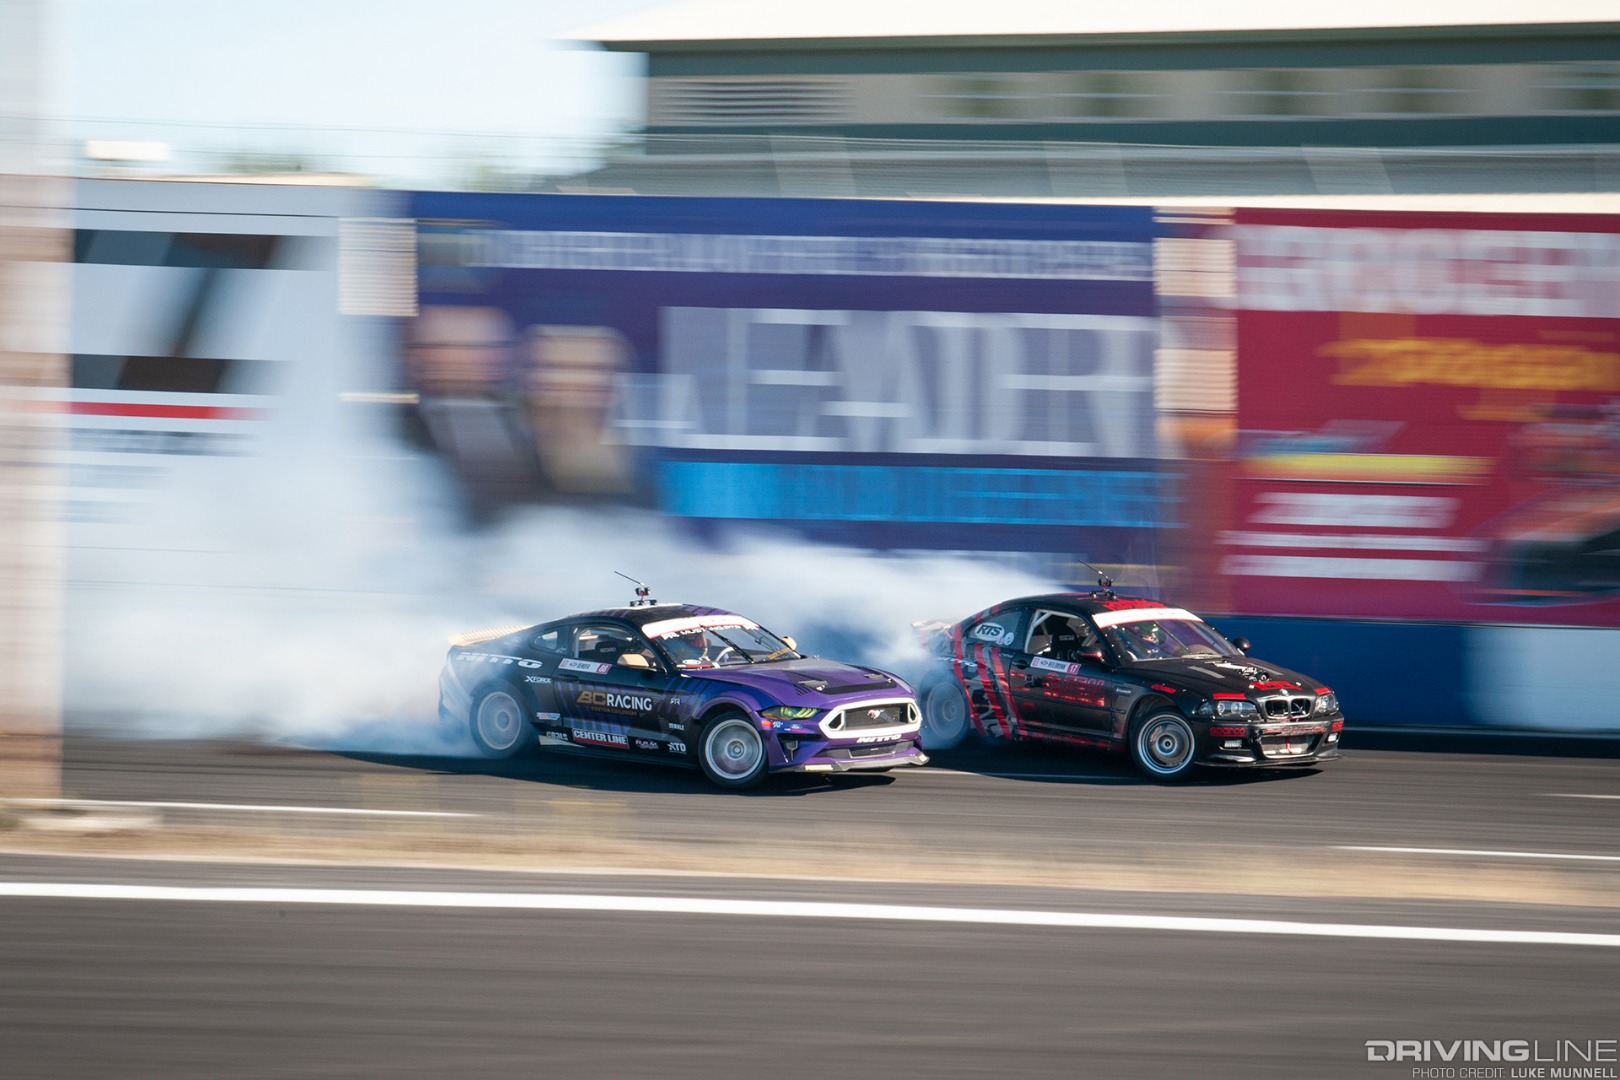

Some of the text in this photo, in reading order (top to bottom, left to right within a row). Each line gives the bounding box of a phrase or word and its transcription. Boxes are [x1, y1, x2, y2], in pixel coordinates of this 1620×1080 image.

[977, 624, 1002, 636] RTS
[1069, 664, 1079, 673] 17
[606, 693, 653, 711] RACING
[573, 730, 605, 742] CENTER
[607, 734, 628, 745] LINE
[856, 733, 902, 743] NITTO
